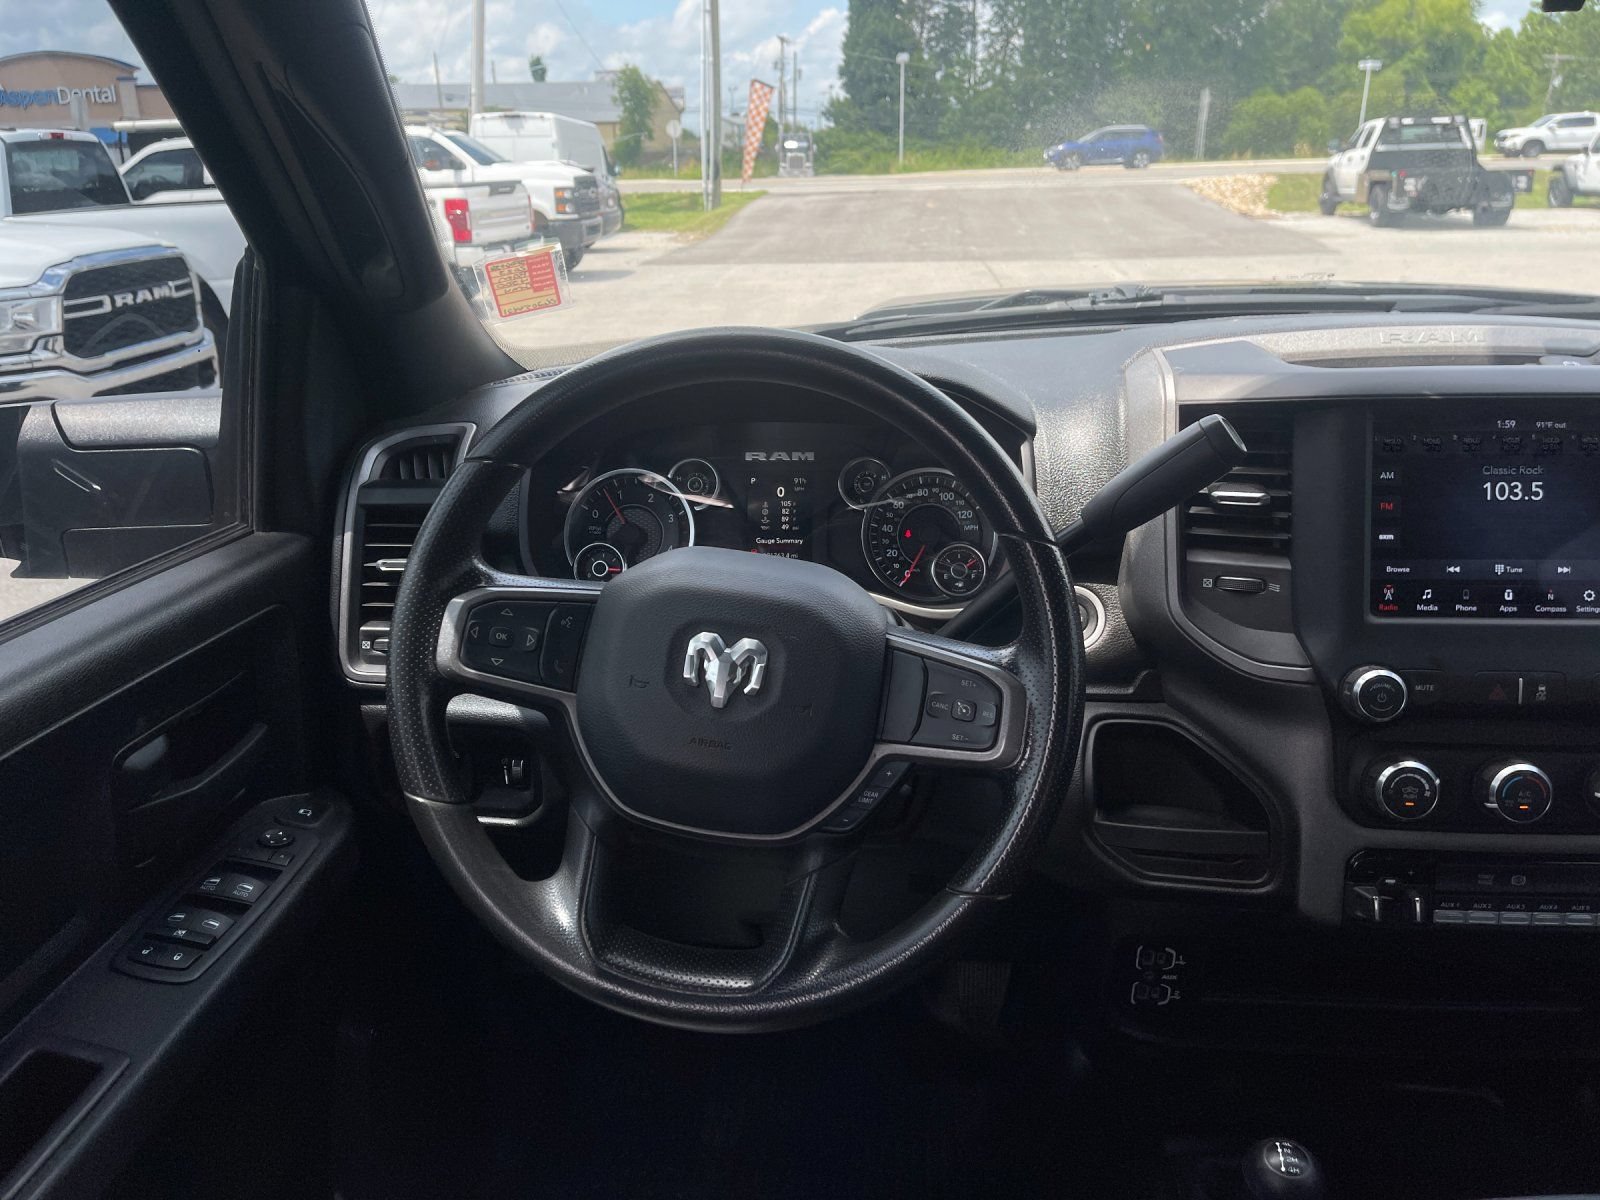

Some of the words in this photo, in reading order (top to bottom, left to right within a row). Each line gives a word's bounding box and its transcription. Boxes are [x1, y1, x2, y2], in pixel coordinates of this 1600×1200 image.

[113, 285, 173, 308] RAM
[1379, 331, 1487, 345] RAM
[1496, 419, 1516, 429] 1:59
[744, 452, 815, 461] RAM
[1482, 465, 1516, 475] Classic
[1519, 465, 1544, 475] Rock
[776, 486, 785, 498] 0
[917, 488, 929, 497] 80
[1482, 481, 1544, 501] 103.5
[647, 493, 654, 503] 2
[938, 492, 955, 501] 100
[892, 500, 904, 509] 60
[1379, 502, 1394, 511] FM
[592, 509, 599, 519] 0
[668, 514, 674, 523] 3
[957, 510, 973, 519] 120
[881, 524, 893, 533] 40
[755, 537, 776, 545] Gauge
[776, 537, 804, 546] Summary
[886, 549, 898, 557] 20
[1386, 565, 1411, 573] Browse
[1505, 565, 1523, 573] Tune
[1378, 604, 1399, 612] Radio
[1455, 604, 1477, 612] Phone
[1499, 605, 1518, 613] Apps
[1534, 605, 1567, 613] Compass
[495, 632, 508, 641] OK
[1414, 684, 1435, 692] MUTE
[931, 701, 949, 711] CANC
[688, 736, 732, 751] AIRBAG
[232, 889, 249, 898] AUTO
